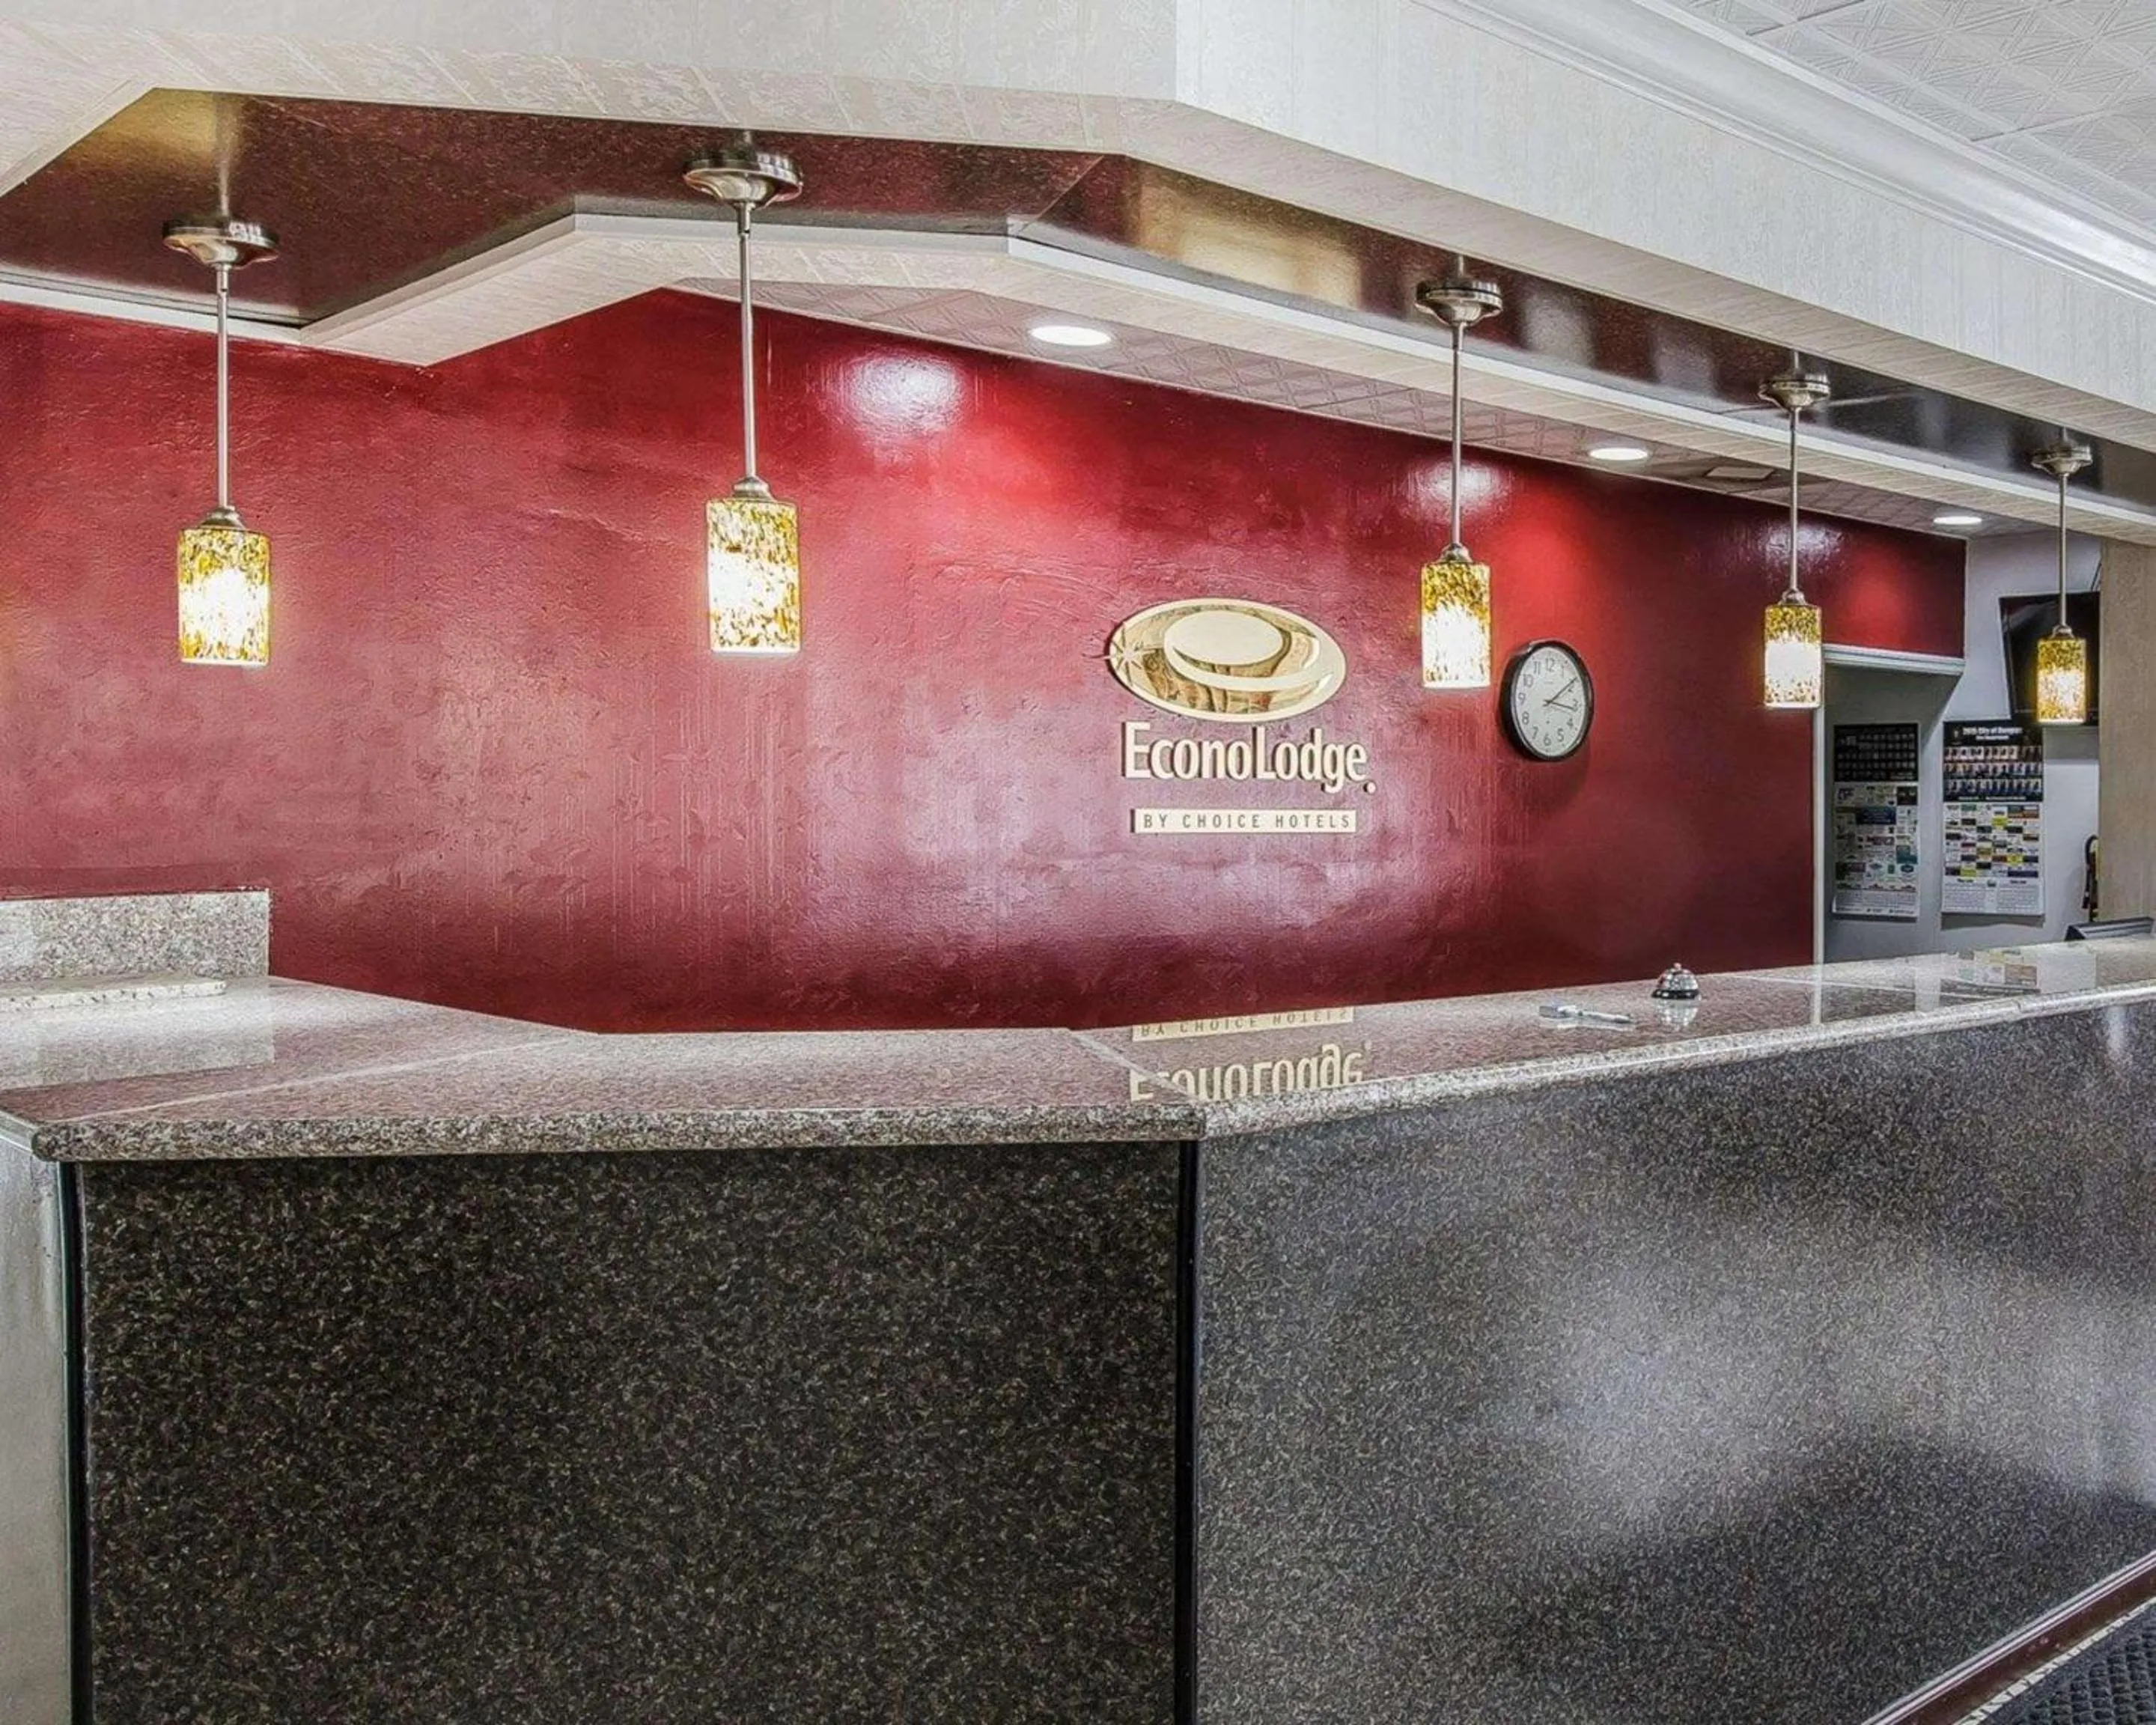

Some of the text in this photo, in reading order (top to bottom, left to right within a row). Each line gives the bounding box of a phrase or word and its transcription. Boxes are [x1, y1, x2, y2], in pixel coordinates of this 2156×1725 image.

[1545, 657, 1555, 672] 12
[1523, 674, 1534, 688] 10
[1517, 692, 1526, 705] 9
[1521, 711, 1530, 725] 8
[1532, 726, 1539, 740] 7
[1543, 733, 1552, 746] 6
[1556, 727, 1565, 743] 5
[1124, 721, 1369, 794] EconoLodge
[1144, 813, 1350, 829] BY CHOICE HOTELS
